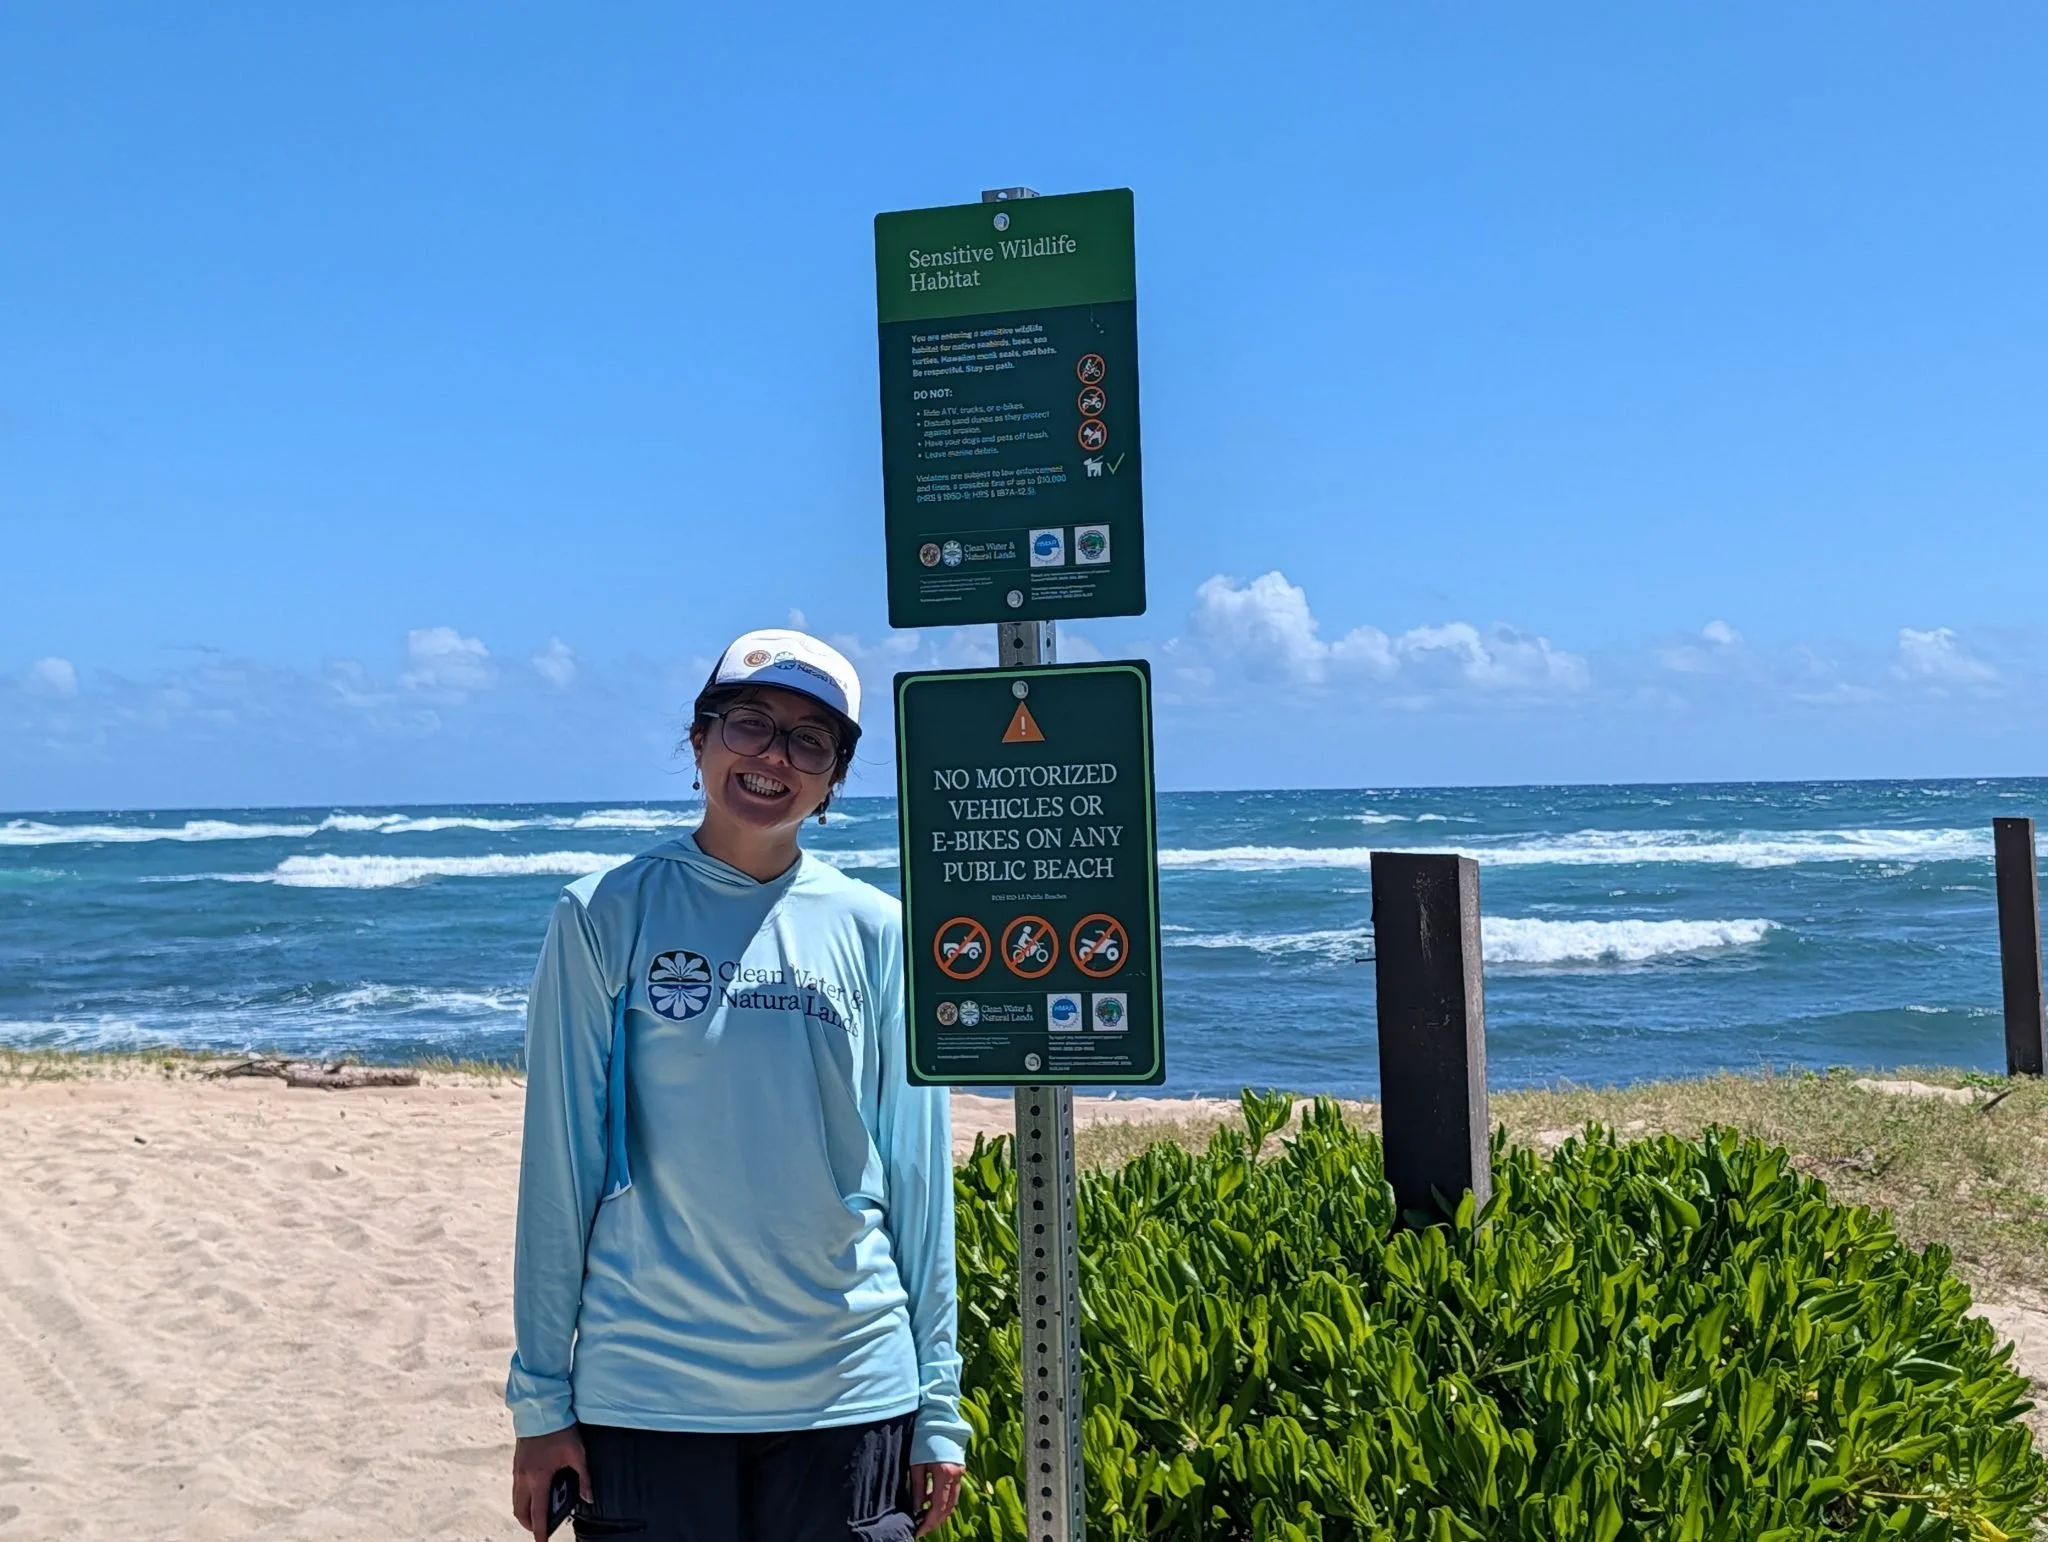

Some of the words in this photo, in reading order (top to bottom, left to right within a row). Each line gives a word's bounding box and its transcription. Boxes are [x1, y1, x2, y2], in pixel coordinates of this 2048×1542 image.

[909, 245, 994, 269] Sensitive
[999, 234, 1077, 260] Wildlife
[909, 270, 981, 292] Habitat
[911, 334, 926, 343] You
[927, 334, 940, 342] are
[940, 331, 973, 341] entering
[980, 327, 1014, 337] sensitive
[1014, 324, 1043, 333] wildlife
[911, 345, 939, 354] habitat
[951, 342, 976, 351] native
[1033, 336, 1048, 344] sea
[940, 354, 976, 363] Hawaiian
[976, 351, 998, 360] monk
[1022, 347, 1037, 357] and
[1037, 346, 1058, 356] bats.
[912, 369, 923, 377] Be
[923, 365, 965, 377] respectful.
[965, 364, 983, 374] Stay
[995, 361, 1015, 371] path.
[913, 389, 928, 401] DO
[929, 388, 953, 399] NOT:
[923, 409, 941, 417] Ride
[986, 405, 995, 413] or
[923, 418, 952, 428] Disturb
[951, 416, 970, 426] sand
[970, 415, 994, 424] dunes
[994, 415, 1004, 423] as
[1004, 412, 1021, 422] they
[1022, 410, 1050, 421] protect
[923, 428, 952, 438] against
[924, 439, 944, 448] Have
[944, 438, 961, 448] your
[961, 437, 981, 446] dogs
[981, 434, 996, 443] and
[996, 434, 1014, 443] pets
[1014, 432, 1026, 441] off
[924, 451, 947, 459] Leave
[947, 449, 974, 458] marine
[916, 473, 950, 482] Violators
[963, 470, 991, 480] subject
[992, 470, 1001, 478] to
[1000, 468, 1015, 477] law
[1015, 465, 1064, 476] enforcement
[916, 484, 931, 493] and
[958, 481, 990, 490] possible
[991, 480, 1005, 488] fine
[1006, 477, 1015, 486] of
[963, 543, 985, 553] Clean
[985, 542, 1008, 551] Water
[1009, 541, 1015, 550] &
[964, 551, 992, 561] Natural
[993, 550, 1016, 560] Lands
[933, 768, 970, 791] NO
[975, 763, 1118, 789] MOTORIZED
[948, 796, 1064, 821] VEHICLES
[1070, 795, 1104, 816] OR
[932, 829, 1020, 852] E-BIKES
[1026, 828, 1063, 849] ON
[1069, 826, 1124, 848] ANY
[943, 860, 1027, 883] PUBLIC
[1033, 857, 1115, 880] BEACH
[718, 960, 787, 985] Clean
[791, 963, 846, 1002] Water
[851, 989, 864, 1012] &
[804, 995, 859, 1038] Lands
[981, 1004, 1002, 1014] Clean
[1004, 1004, 1025, 1013] Water
[1026, 1003, 1033, 1013] &
[981, 1013, 1010, 1022] Natural
[1011, 1012, 1034, 1022] Lands
